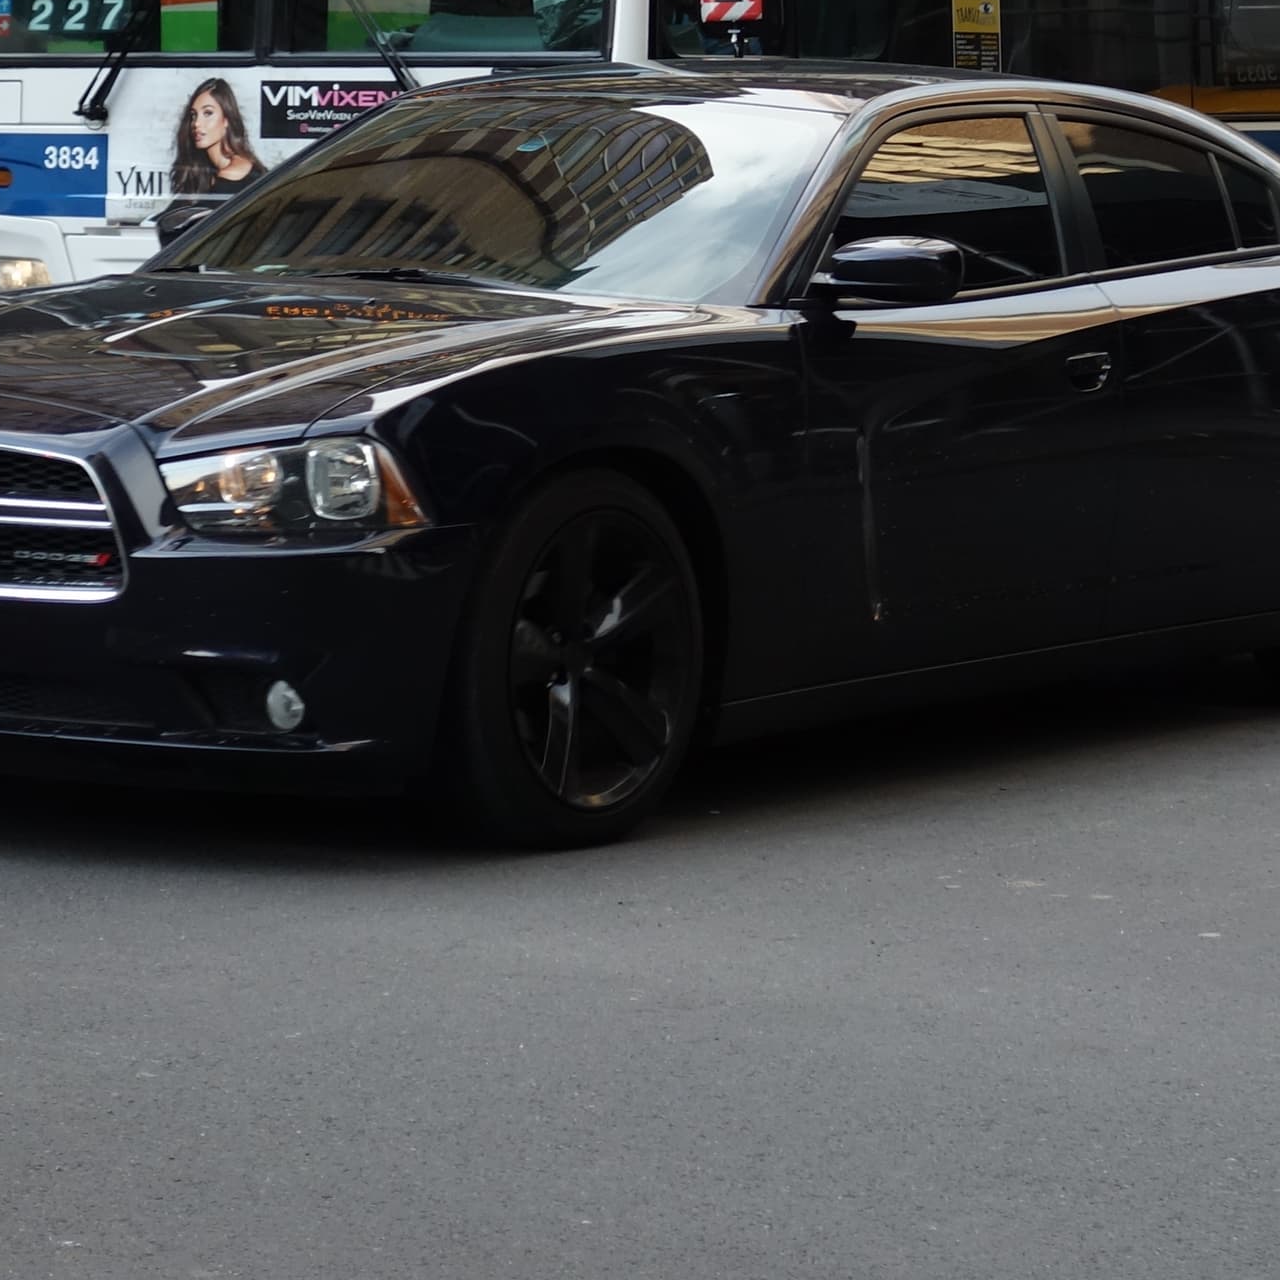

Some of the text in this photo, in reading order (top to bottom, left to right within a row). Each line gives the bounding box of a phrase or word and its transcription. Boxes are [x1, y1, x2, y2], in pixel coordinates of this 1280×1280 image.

[43, 145, 99, 170] 3834
[115, 166, 166, 196] YMI
[13, 550, 99, 563] DODGE
